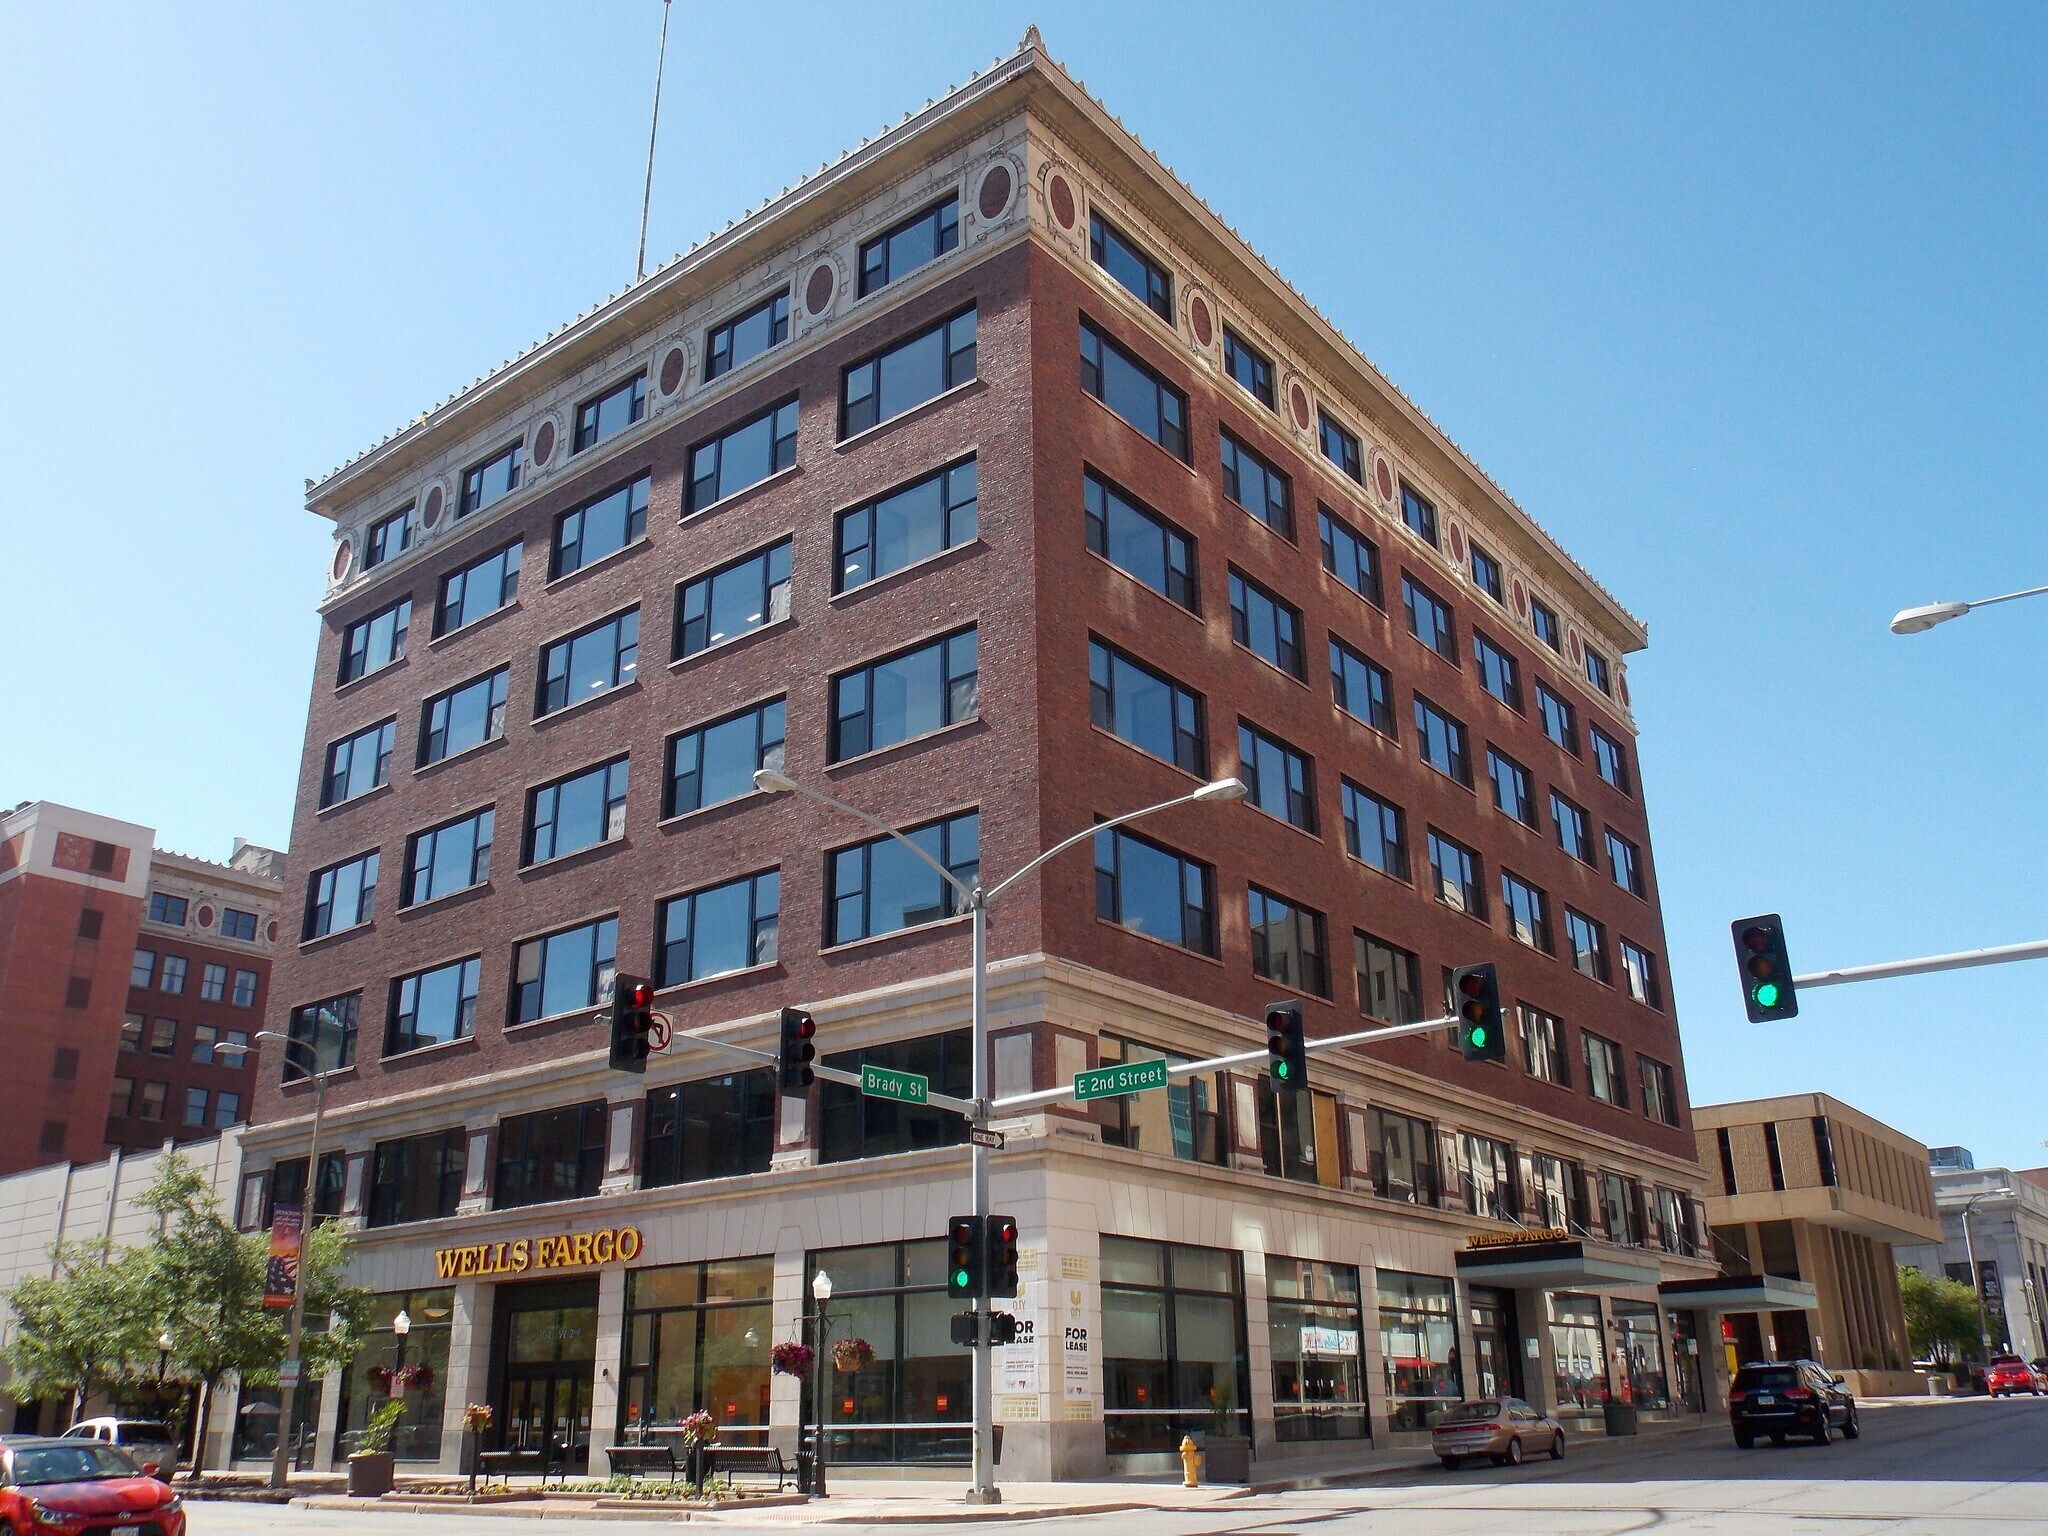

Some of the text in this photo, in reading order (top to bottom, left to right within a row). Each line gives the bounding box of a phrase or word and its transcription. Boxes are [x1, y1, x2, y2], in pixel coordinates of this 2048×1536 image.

[868, 1073, 922, 1098] Brady St
[1078, 1067, 1162, 1094] E 2nd Street
[974, 1132, 996, 1144] ONE WAY
[1466, 1228, 1566, 1247] WELLS FARGO
[435, 1226, 644, 1278] WELLS FARGO
[1014, 1320, 1034, 1334] OR
[1065, 1327, 1087, 1340] FOR
[1010, 1335, 1035, 1344] ASE
[1065, 1341, 1088, 1352] LEASE
